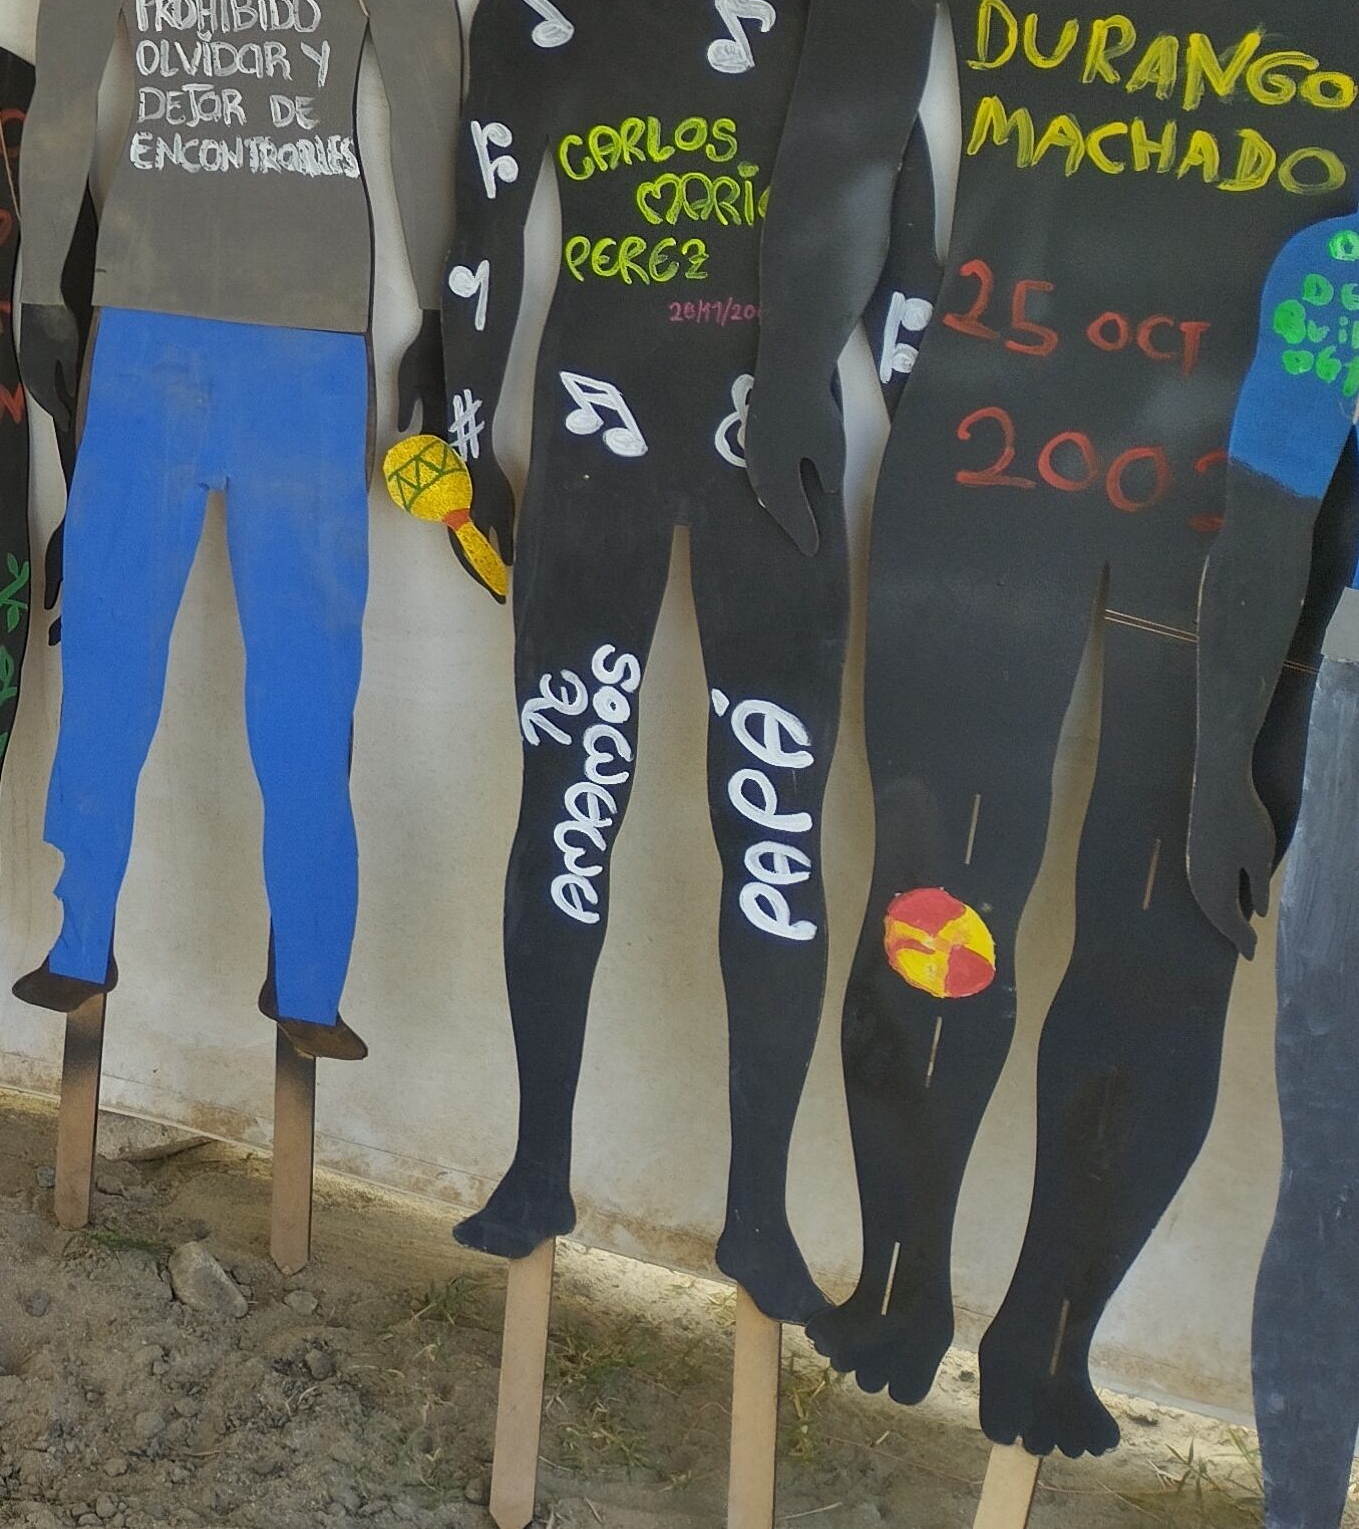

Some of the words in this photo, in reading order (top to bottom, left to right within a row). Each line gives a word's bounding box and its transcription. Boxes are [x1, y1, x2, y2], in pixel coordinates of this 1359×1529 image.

[300, 40, 331, 88] Y
[269, 93, 322, 131] DE
[558, 115, 738, 181] CARLOS
[966, 95, 1347, 195] MACHADO
[564, 235, 709, 286] PEREZ
[942, 258, 1059, 358] 25
[1085, 309, 1212, 378] OCT
